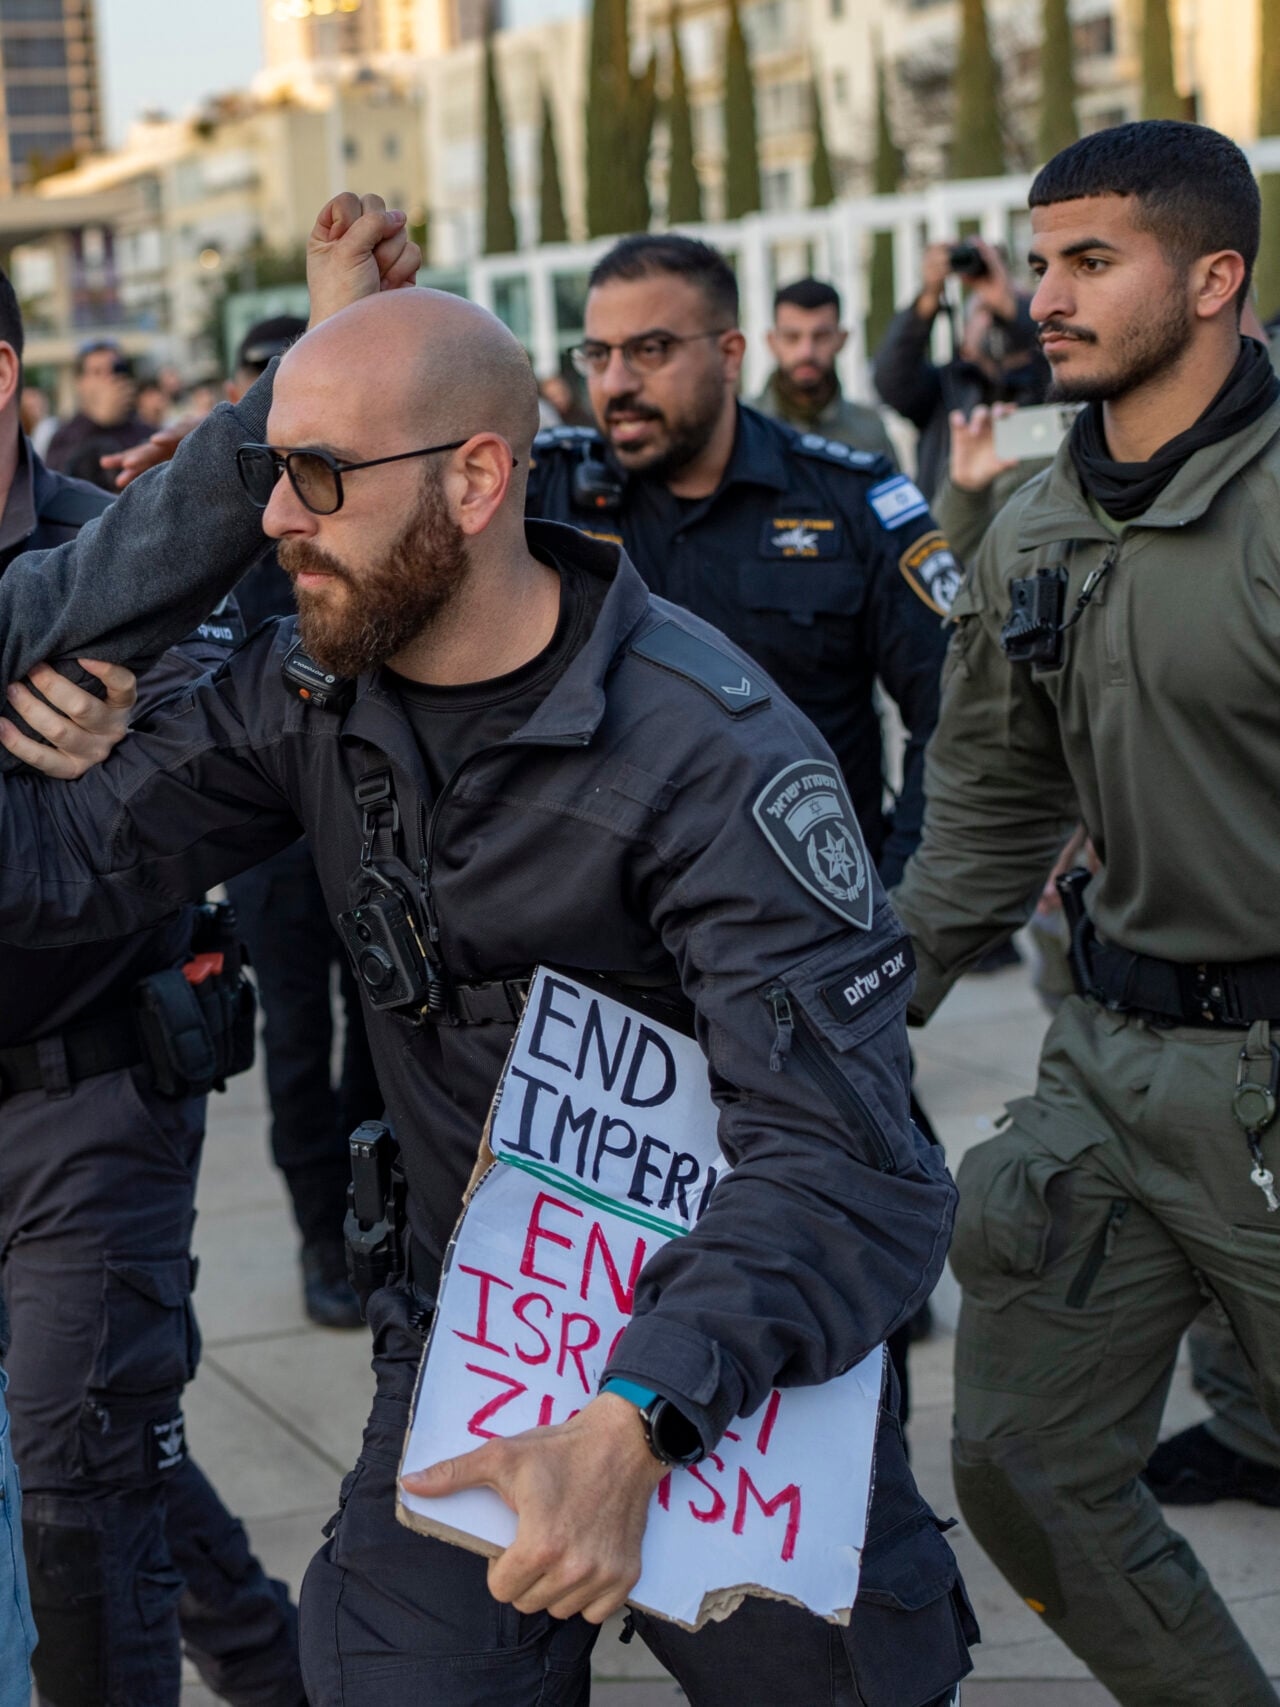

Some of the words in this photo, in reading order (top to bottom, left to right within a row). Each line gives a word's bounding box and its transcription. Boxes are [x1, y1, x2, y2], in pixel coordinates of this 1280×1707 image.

[766, 781, 801, 819] ישראל
[801, 774, 838, 790] משטרת
[881, 952, 906, 978] אבי
[843, 970, 880, 1006] שלום
[528, 976, 677, 1107] END
[500, 1066, 718, 1221] IMPERI
[520, 1192, 646, 1315] EN
